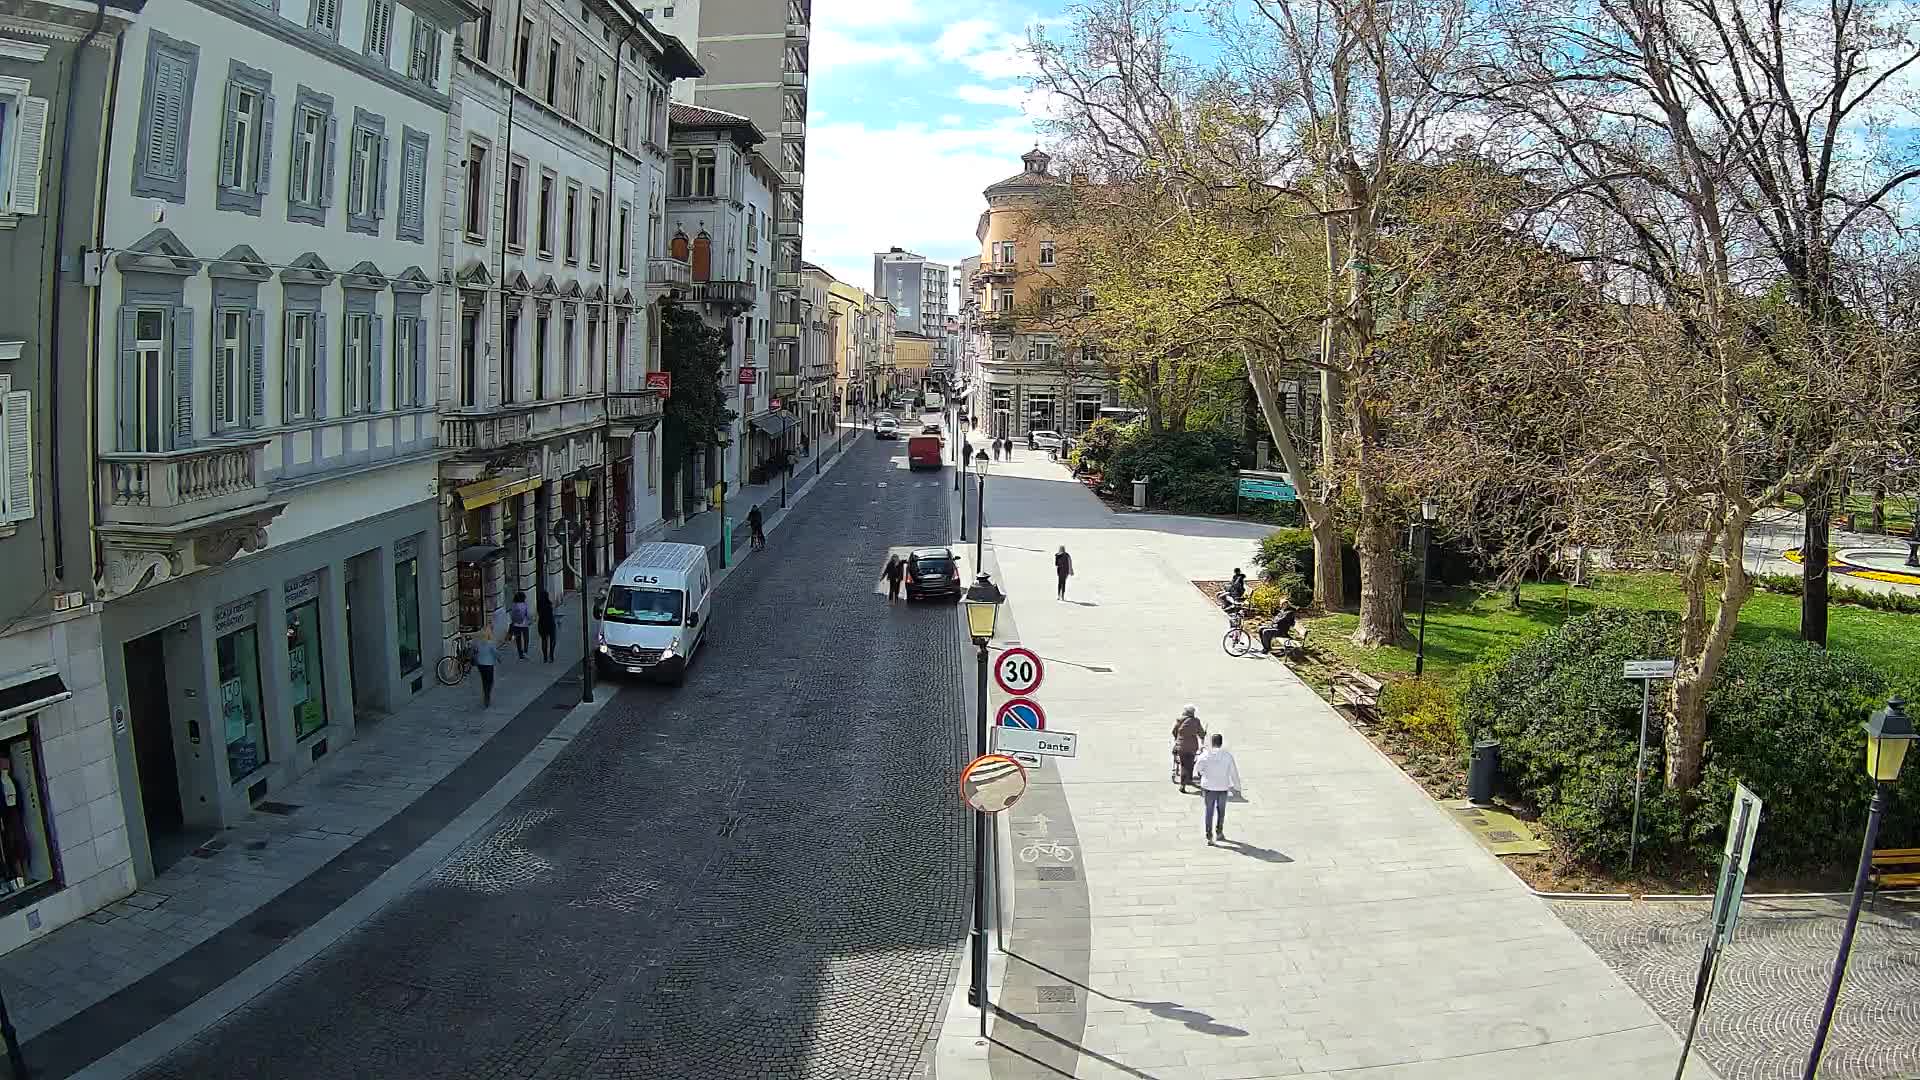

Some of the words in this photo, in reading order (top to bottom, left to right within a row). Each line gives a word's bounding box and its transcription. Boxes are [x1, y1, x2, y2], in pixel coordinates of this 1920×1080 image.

[634, 576, 659, 584] GLS
[1006, 660, 1032, 682] 30
[1039, 741, 1070, 751] Dante
